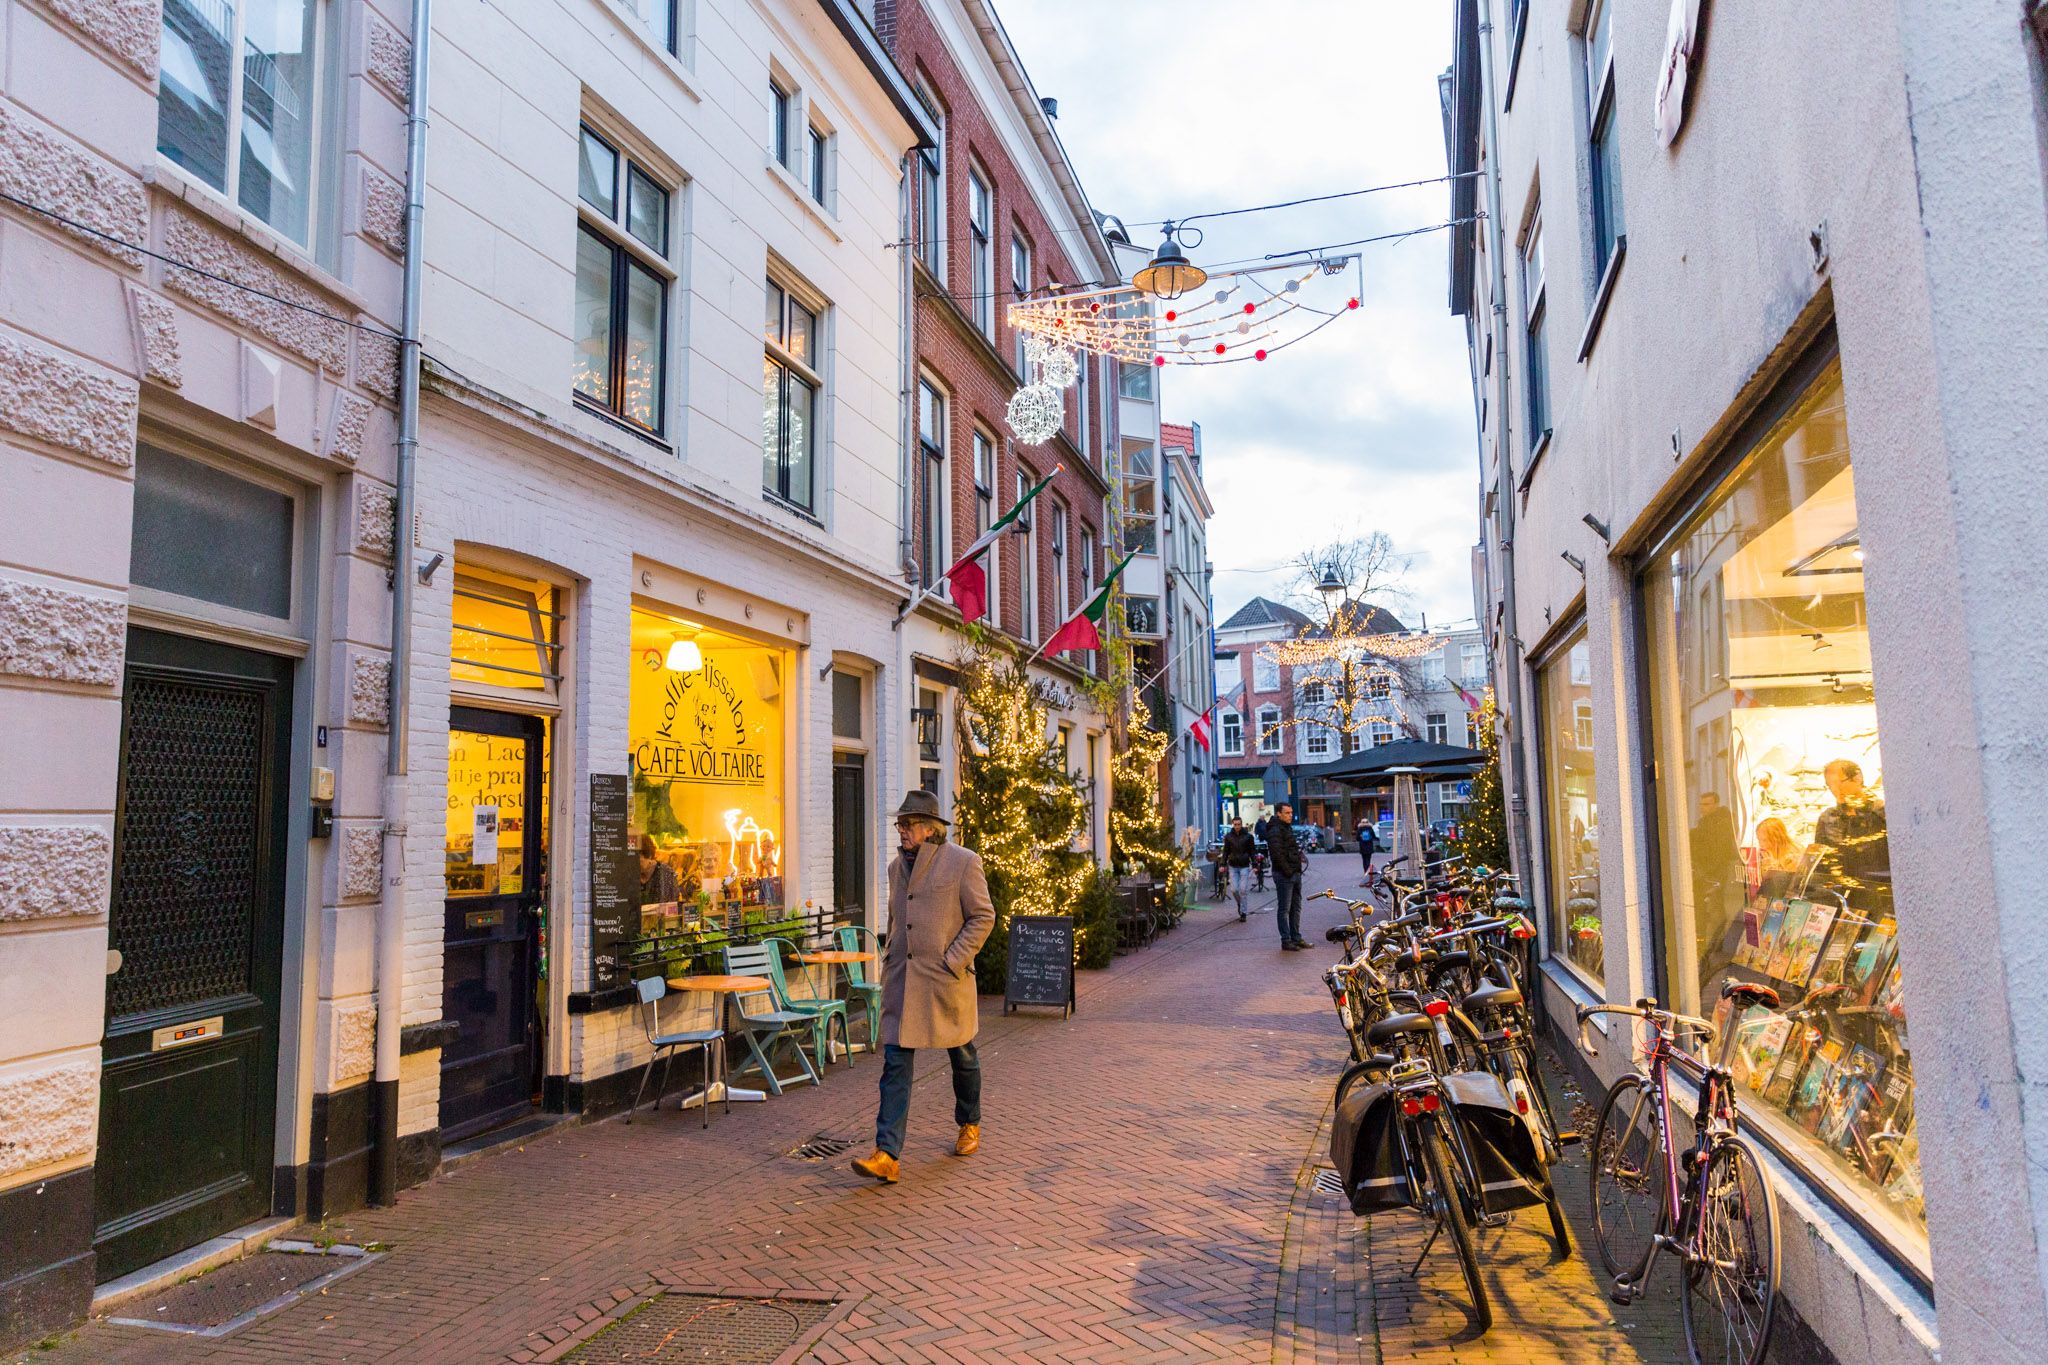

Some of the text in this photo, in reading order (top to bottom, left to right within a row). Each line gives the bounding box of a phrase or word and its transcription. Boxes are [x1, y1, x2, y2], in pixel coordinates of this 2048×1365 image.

[318, 728, 326, 746] 4
[636, 744, 765, 779] CAFÉ VOLTAIRE
